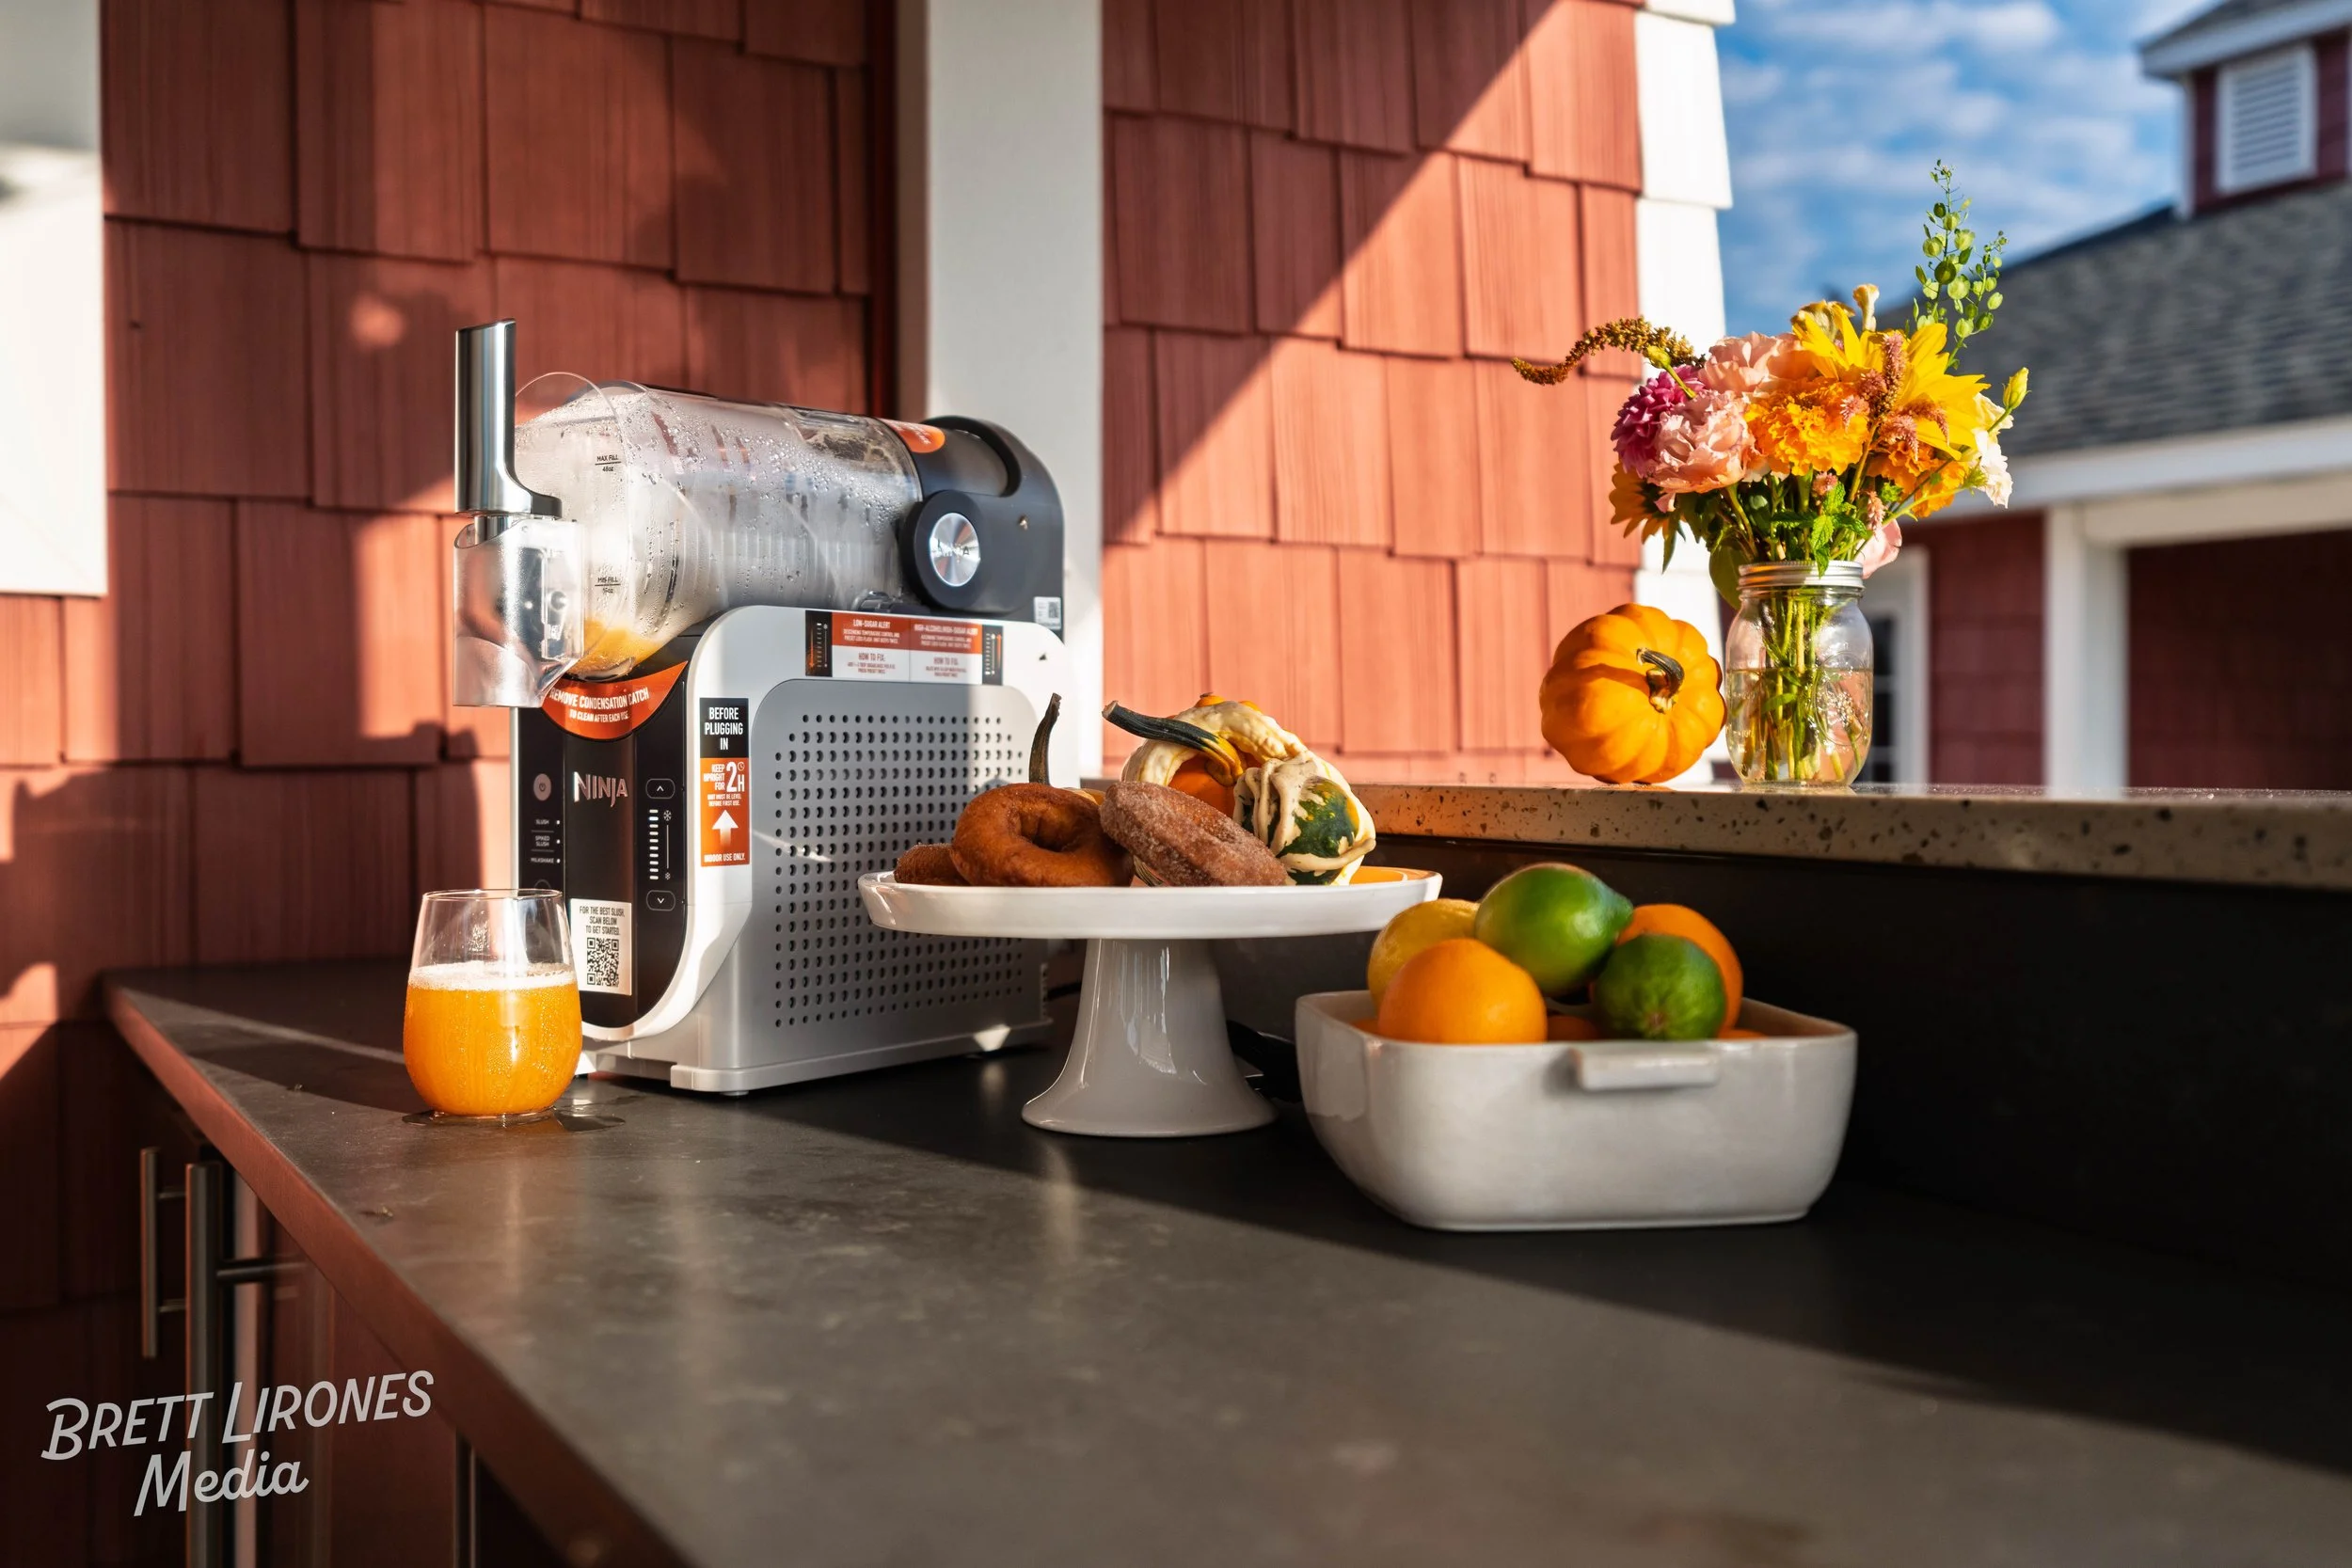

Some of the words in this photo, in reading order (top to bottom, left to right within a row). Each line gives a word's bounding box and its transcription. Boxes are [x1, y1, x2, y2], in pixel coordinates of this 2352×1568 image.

[549, 688, 579, 707] REMOVE
[580, 695, 628, 710] CONDENSATION
[628, 687, 650, 705] CATCH
[569, 709, 578, 719] TO
[578, 709, 595, 722] CLEAN
[595, 713, 609, 723] AFTER
[609, 712, 621, 723] EACH
[708, 706, 739, 721] BEFORE
[704, 721, 743, 736] PLUGGING
[720, 737, 729, 751] IN
[711, 763, 725, 772] KEEP
[703, 772, 725, 783] UPRIGHT
[573, 771, 628, 808] NINJA
[714, 782, 725, 791] FOR
[704, 853, 723, 863] INDOOR
[723, 853, 733, 862] USE
[733, 852, 746, 862] ONLY.
[579, 905, 589, 914] FOR
[590, 906, 598, 915] THE
[599, 907, 611, 916] BEST
[589, 915, 602, 925] SCAN
[602, 916, 617, 926] BELOW
[585, 925, 592, 934] TO
[592, 926, 601, 935] GET
